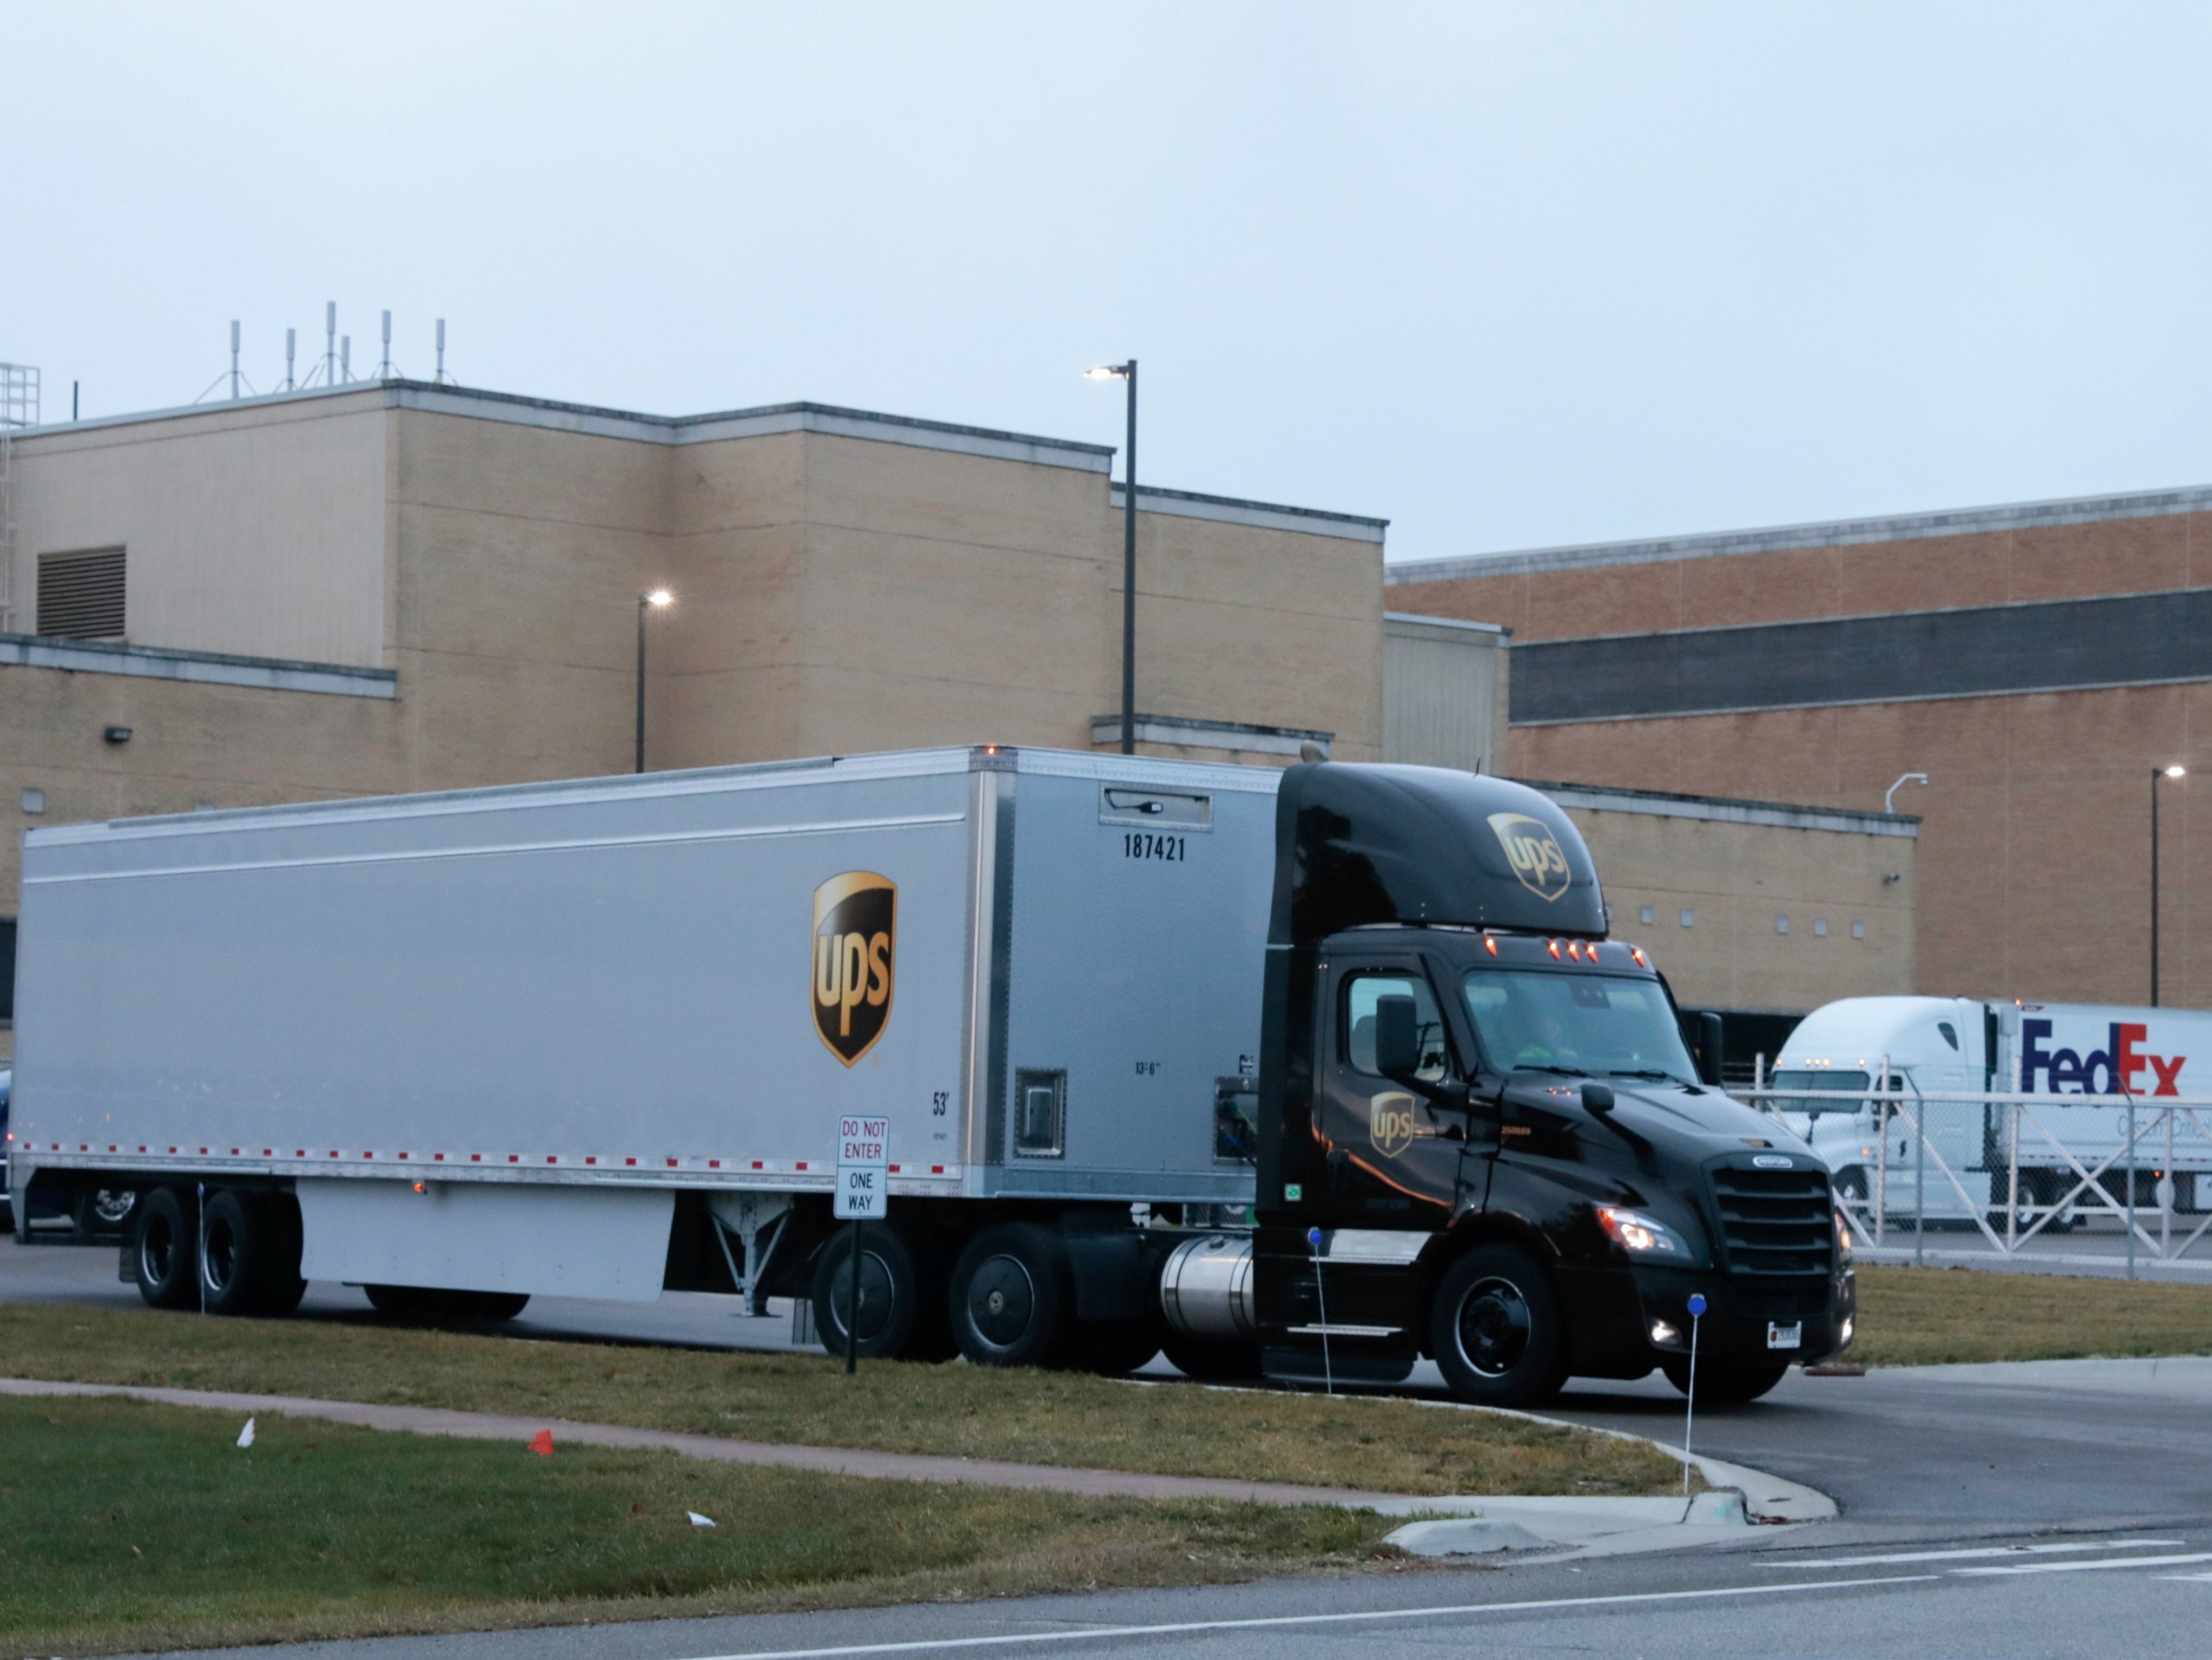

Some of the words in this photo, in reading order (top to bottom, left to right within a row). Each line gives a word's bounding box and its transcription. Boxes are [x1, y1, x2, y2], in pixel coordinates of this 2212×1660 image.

[1125, 833, 1184, 861] 187421
[1502, 836, 1566, 886] ups
[817, 931, 889, 1037] ups
[2021, 1018, 2187, 1108] FedEx
[933, 1092, 949, 1116] 53'
[842, 1121, 859, 1136] DO
[864, 1121, 886, 1137] NOT
[1374, 1112, 1411, 1148] ups
[845, 1143, 882, 1159] ENTER
[850, 1172, 873, 1189] ONE
[849, 1195, 873, 1210] WAY
